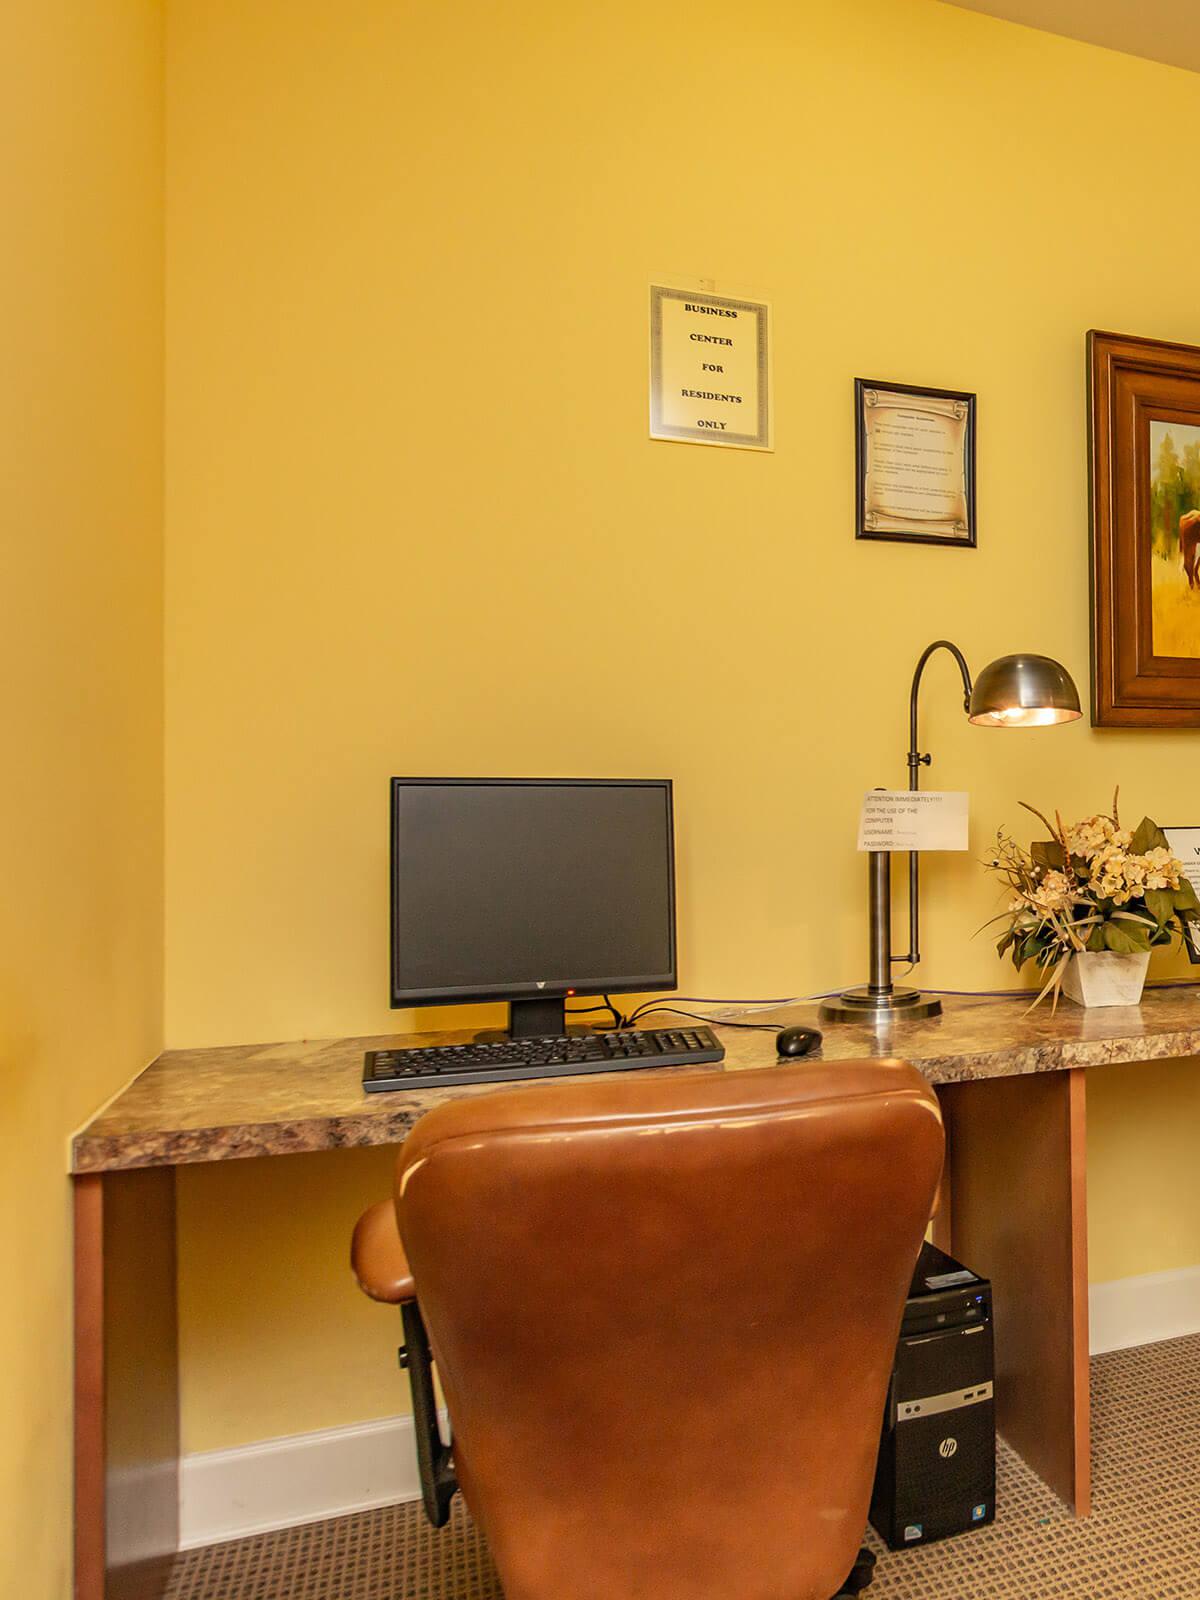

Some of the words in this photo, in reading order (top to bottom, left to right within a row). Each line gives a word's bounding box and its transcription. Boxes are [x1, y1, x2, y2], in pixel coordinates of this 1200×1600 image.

[685, 303, 738, 318] BUSINESS
[689, 333, 733, 346] CENTER
[702, 363, 724, 373] FOR
[681, 388, 742, 403] RESIDENTS
[697, 419, 727, 430] ONLY
